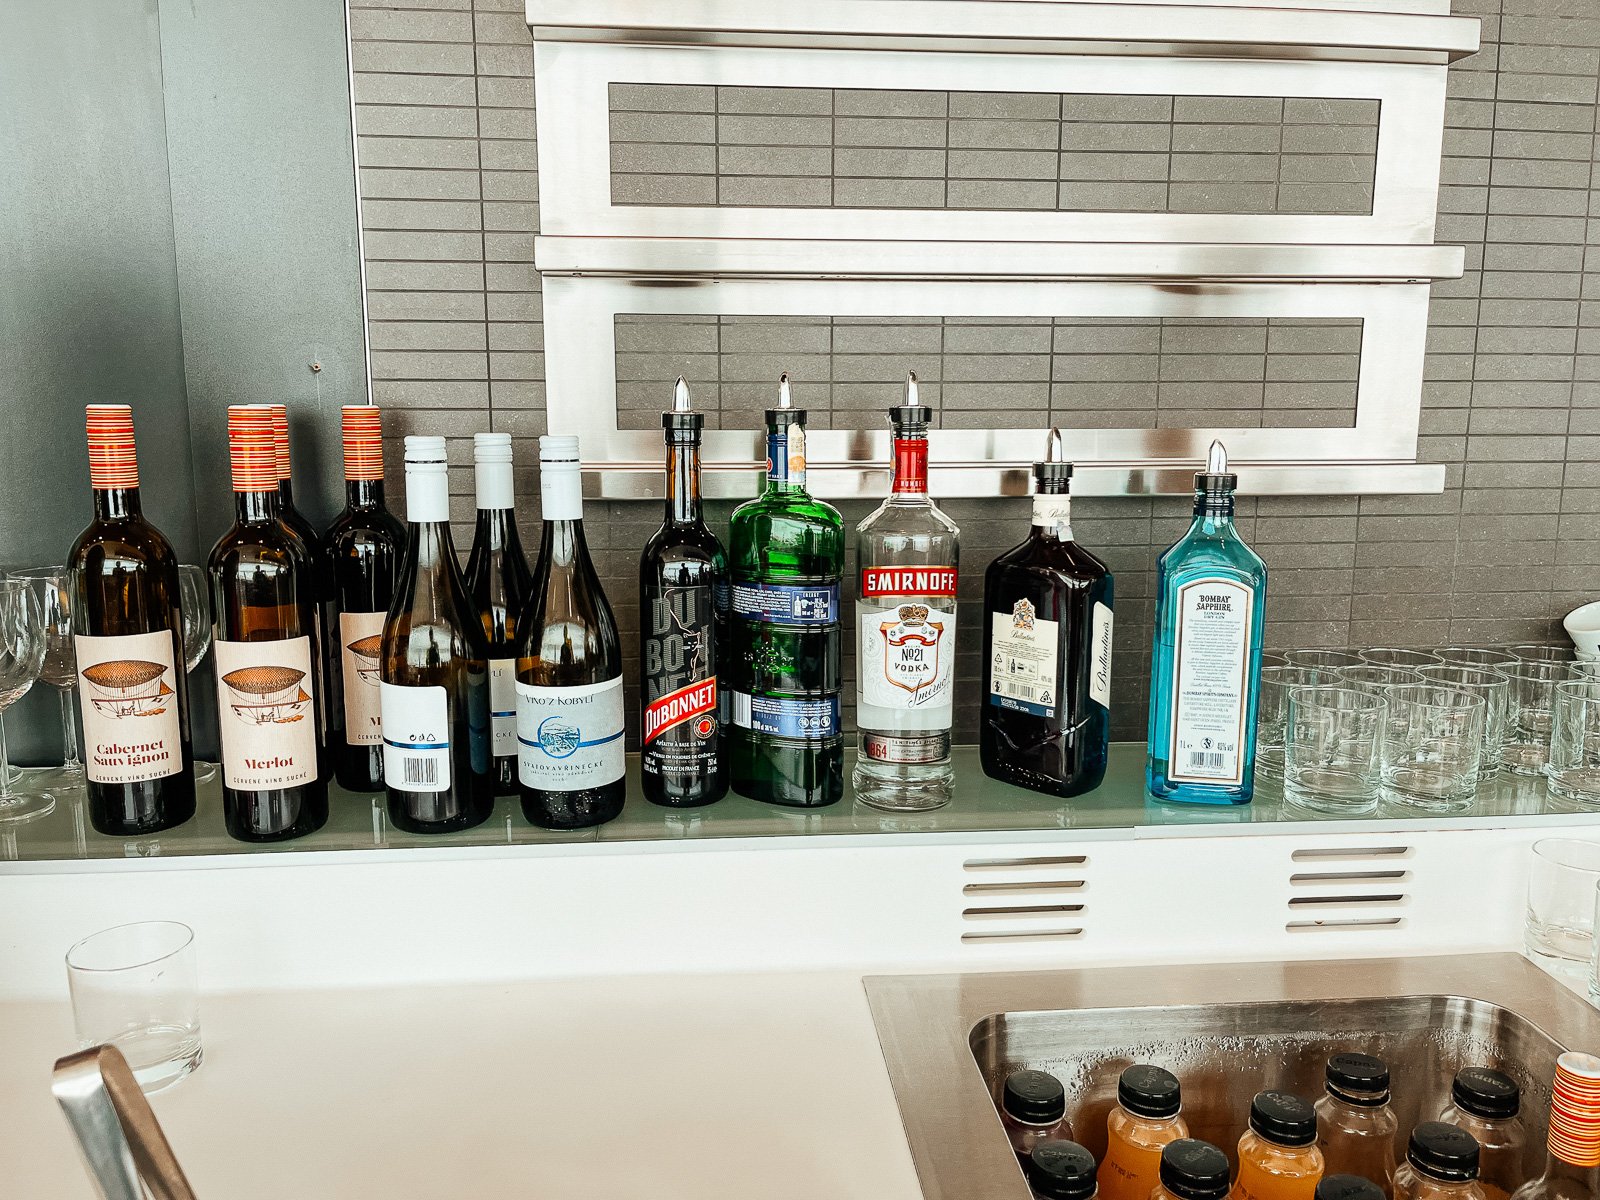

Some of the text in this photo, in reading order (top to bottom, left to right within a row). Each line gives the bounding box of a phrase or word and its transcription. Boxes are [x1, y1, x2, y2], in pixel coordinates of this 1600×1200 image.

[867, 571, 954, 592] SMIRNOFF
[1198, 594, 1232, 603] BOMBAY
[1196, 602, 1232, 612] SAPPHIRE
[1096, 621, 1110, 692] Ballantine's
[894, 662, 930, 673] VODKA
[645, 684, 714, 740] DUBONNET
[96, 740, 164, 755] Cabernet
[93, 751, 170, 767] Sauvignon
[244, 756, 294, 770] Merlot
